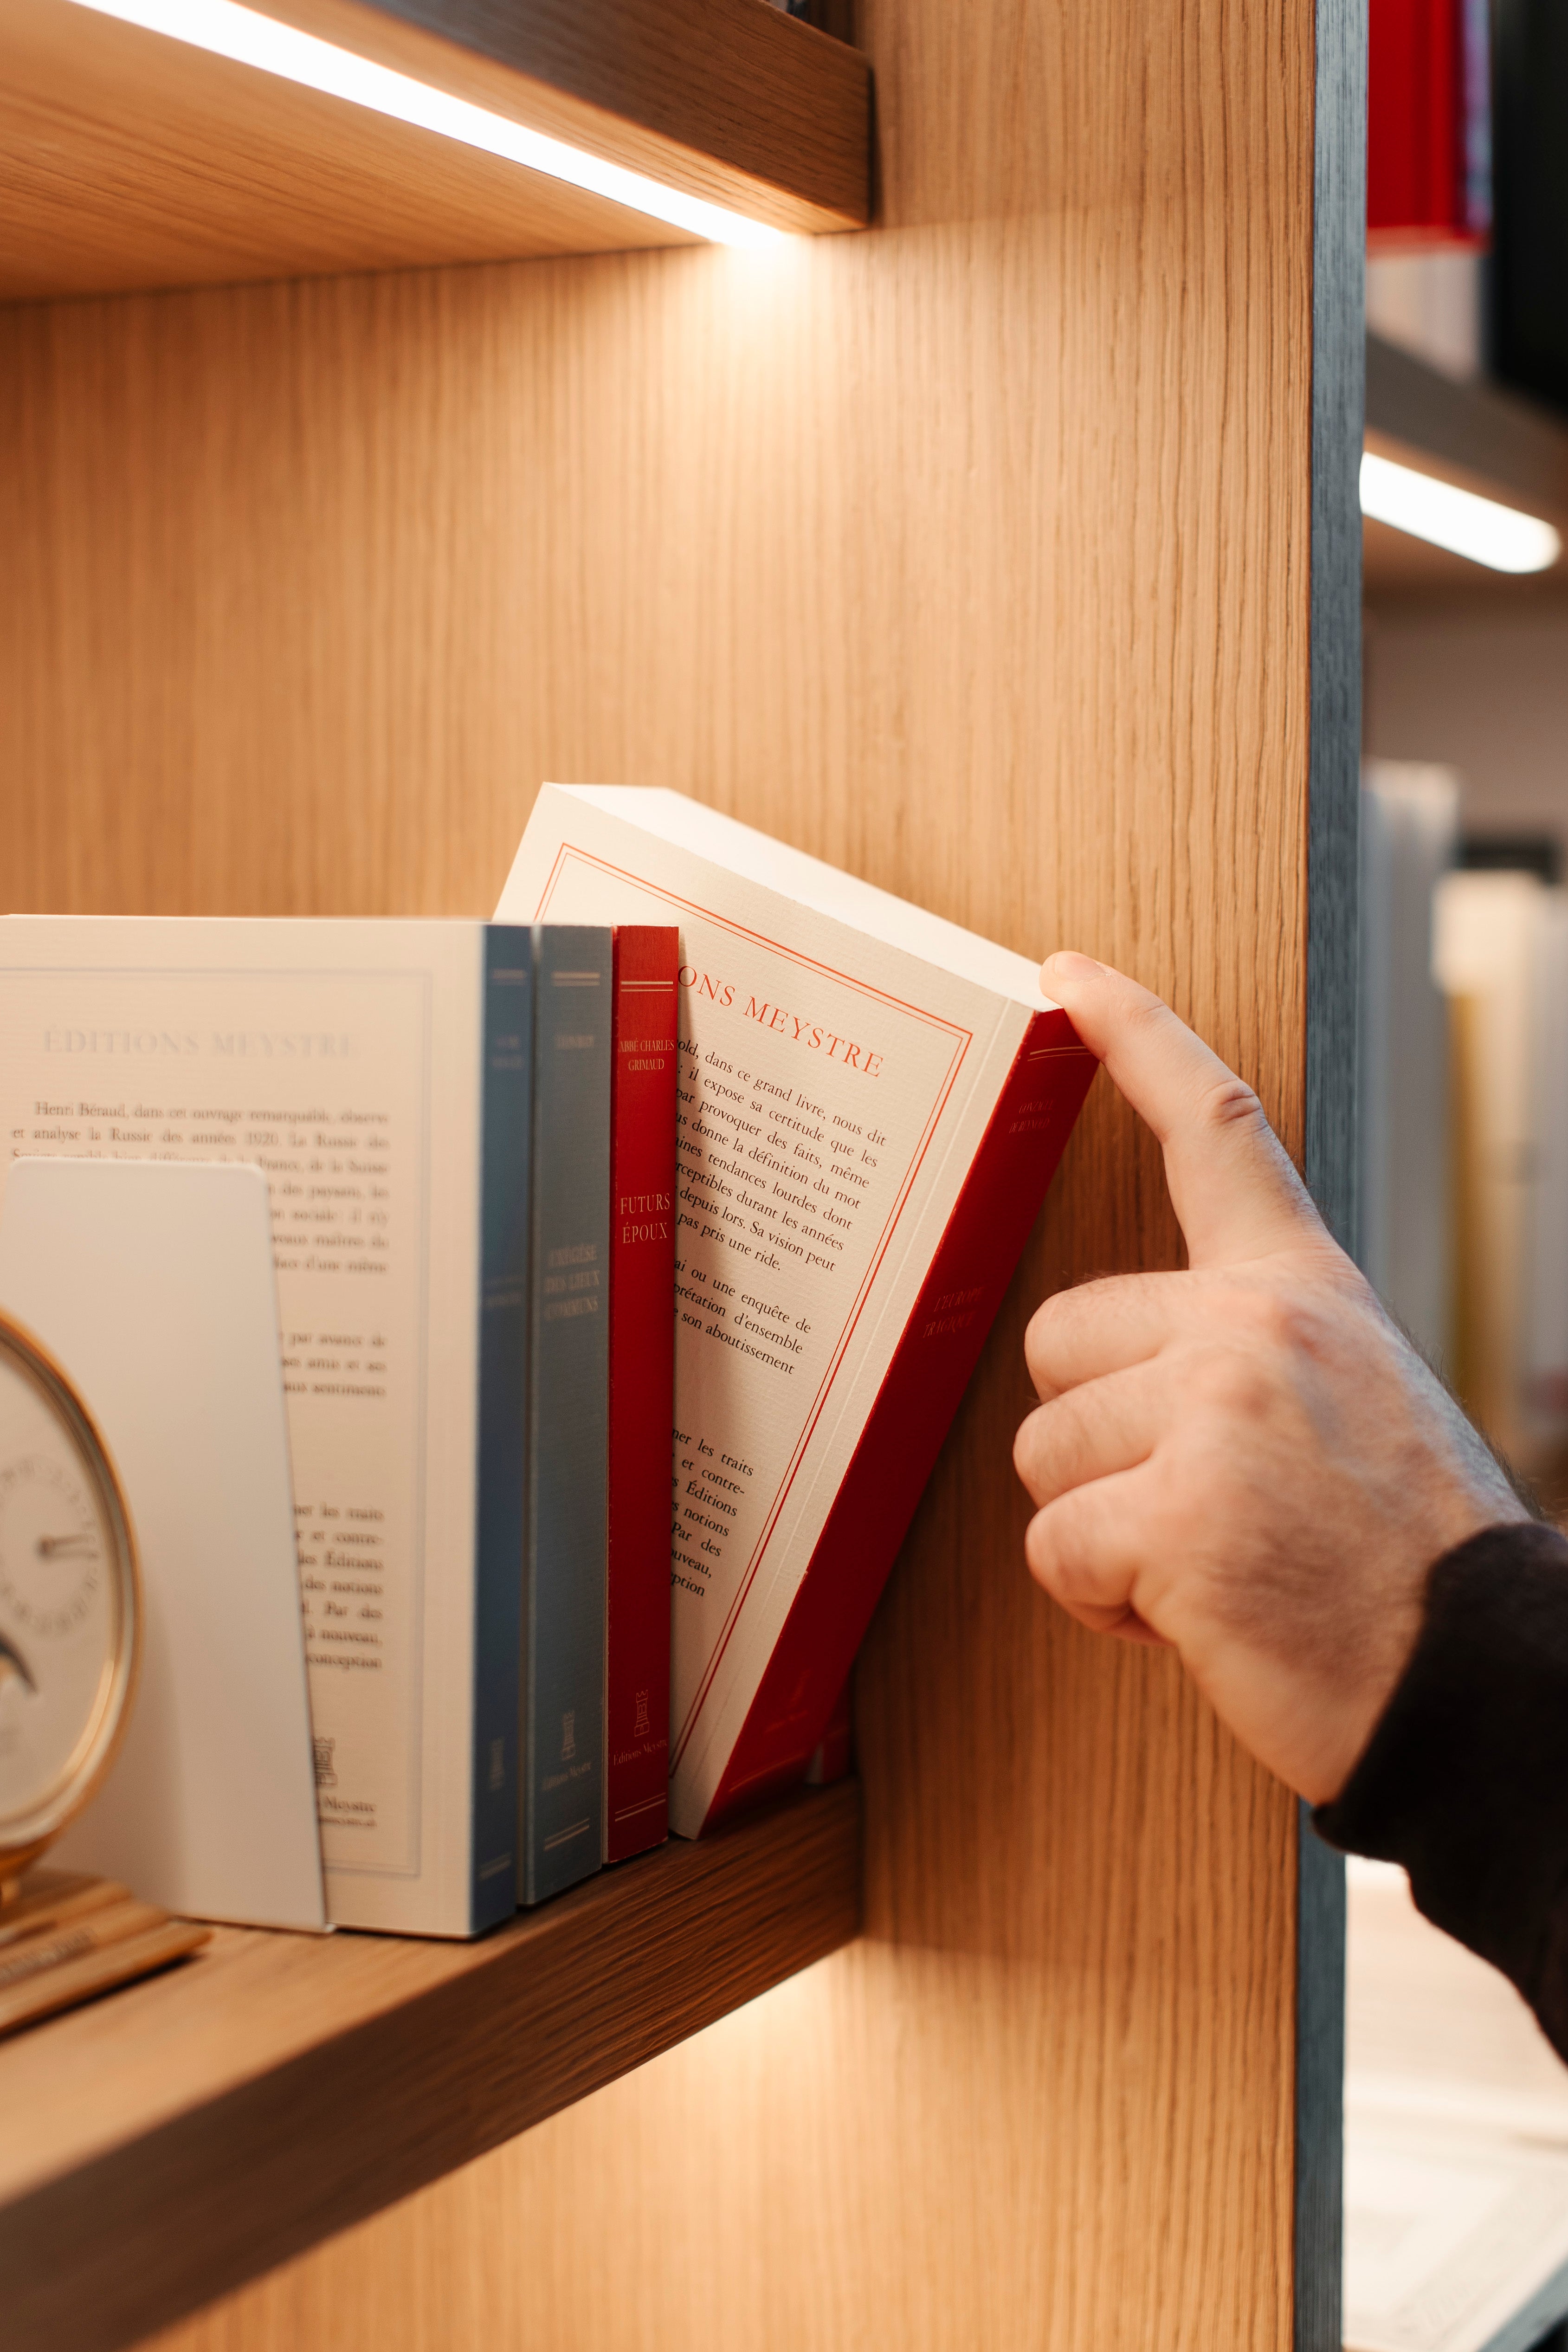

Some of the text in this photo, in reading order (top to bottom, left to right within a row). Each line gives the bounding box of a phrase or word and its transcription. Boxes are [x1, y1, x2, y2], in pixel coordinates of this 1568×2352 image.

[44, 1024, 360, 1060] ÉDITIONS MEYSTRE
[640, 1040, 674, 1052] CHARLES
[742, 995, 883, 1077] MEYSTRE
[628, 1059, 665, 1071] GRIMAUD
[36, 1101, 74, 1116] Henri
[79, 1102, 129, 1120] Béraud,
[135, 1104, 164, 1118] dans
[678, 1039, 886, 1146] old, dans ce grand livre, nous dit
[12, 1129, 26, 1139] et
[34, 1126, 82, 1143] analyse
[90, 1127, 101, 1140] la
[110, 1128, 153, 1143] Russie
[688, 1066, 699, 1081] il
[704, 1079, 744, 1104] expose
[749, 1101, 762, 1113] sa
[769, 1111, 824, 1142] certitude
[831, 1140, 854, 1156] que
[860, 1150, 877, 1167] les
[691, 1118, 729, 1145] donne
[732, 1137, 743, 1153] la
[748, 1147, 808, 1185] définition
[813, 1178, 830, 1195] du
[834, 1191, 861, 1209] mot
[697, 1101, 762, 1137] provoquer
[767, 1131, 787, 1150] des
[793, 1143, 822, 1169] faits,
[830, 1164, 869, 1188] même
[620, 1193, 670, 1215] FUTURS
[676, 1163, 844, 1251] rceptibles durant les années
[708, 1153, 767, 1189] tendances
[771, 1182, 817, 1213] lourdes
[823, 1208, 853, 1230] dont
[622, 1222, 668, 1244] ÉPOUX
[677, 1213, 781, 1271] pas pris une ride.
[679, 1186, 836, 1272] depuis lors. Sa vision peut
[691, 1269, 707, 1283] ou
[713, 1279, 736, 1297] une
[741, 1294, 790, 1323] enquête
[795, 1318, 811, 1333] de
[681, 1313, 702, 1330] son
[705, 1324, 795, 1375] aboutissement
[734, 1312, 803, 1354] d'ensemble
[697, 1438, 715, 1457] les
[721, 1454, 754, 1476] traits
[681, 1459, 745, 1494] et contre-
[685, 1480, 737, 1517] Éditions
[683, 1508, 729, 1537] notions
[700, 1538, 722, 1557] des
[671, 1572, 705, 1597] ption
